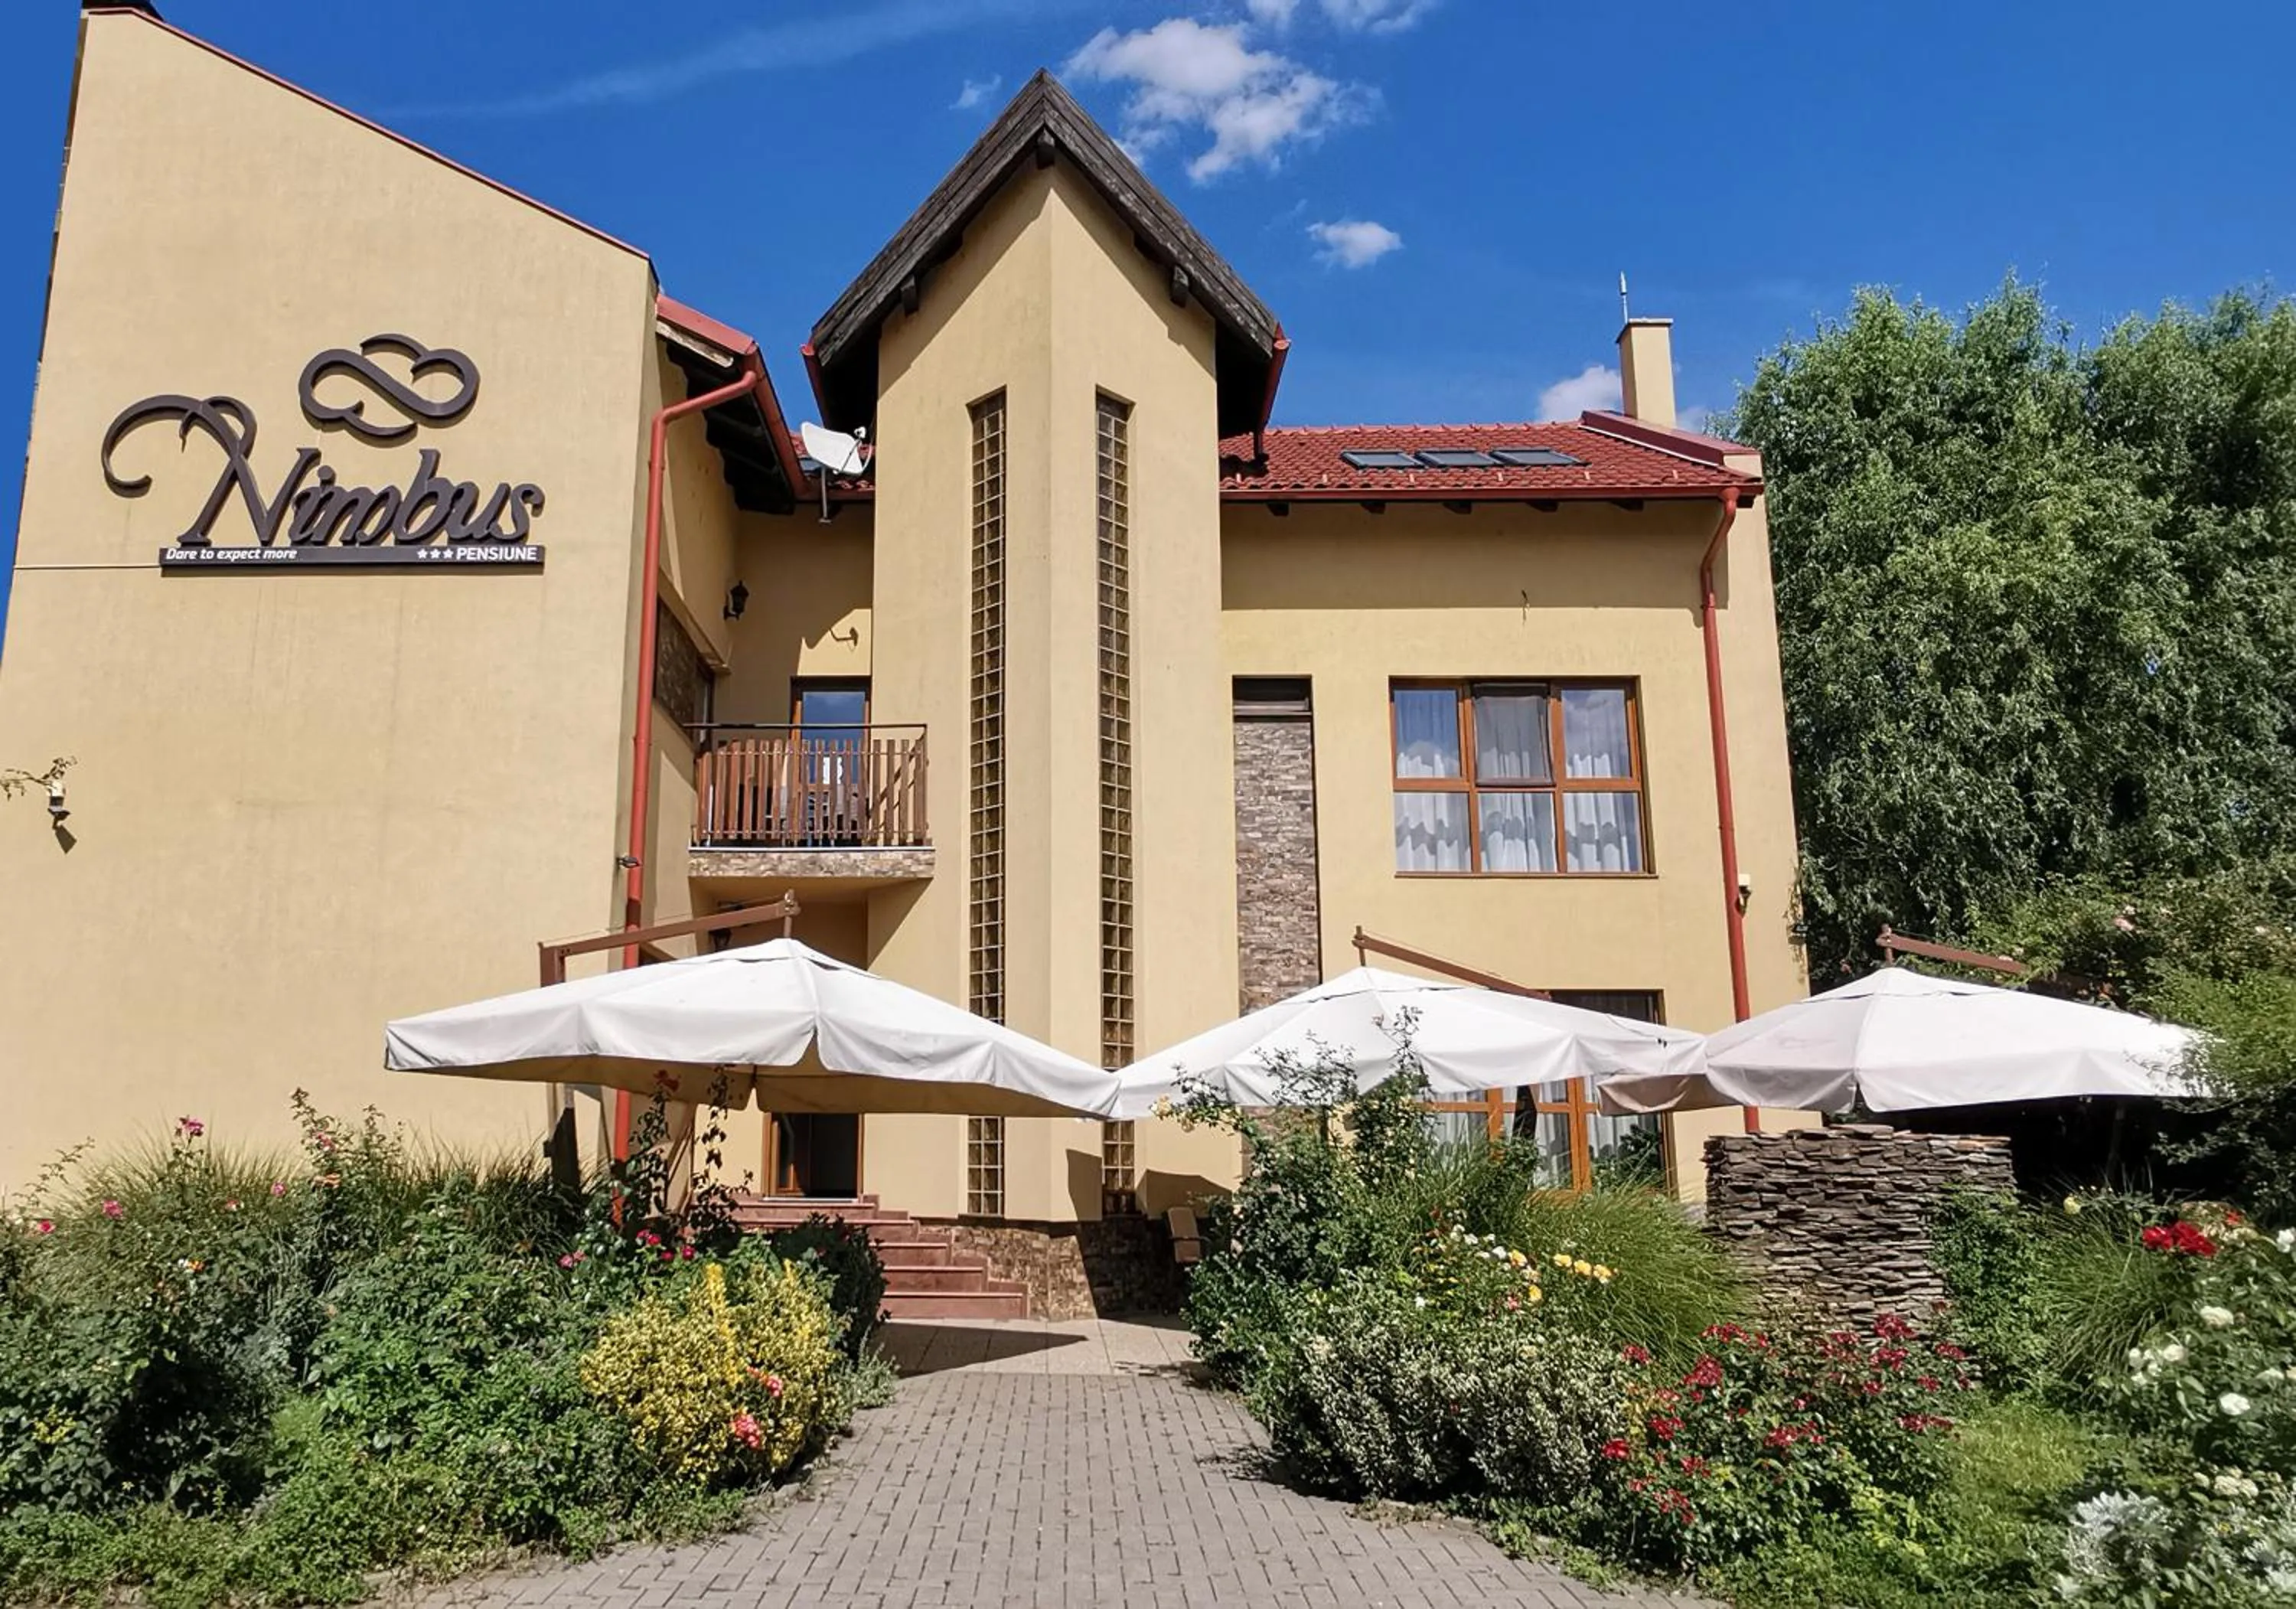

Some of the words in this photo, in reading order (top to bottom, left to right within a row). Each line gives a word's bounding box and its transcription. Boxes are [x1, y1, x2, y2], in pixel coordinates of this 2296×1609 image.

[101, 395, 546, 546] Nimbus
[166, 549, 197, 560] Dare
[201, 550, 214, 560] to
[217, 550, 260, 561] expect
[263, 550, 297, 560] more
[456, 547, 537, 560] PENSIUNE
